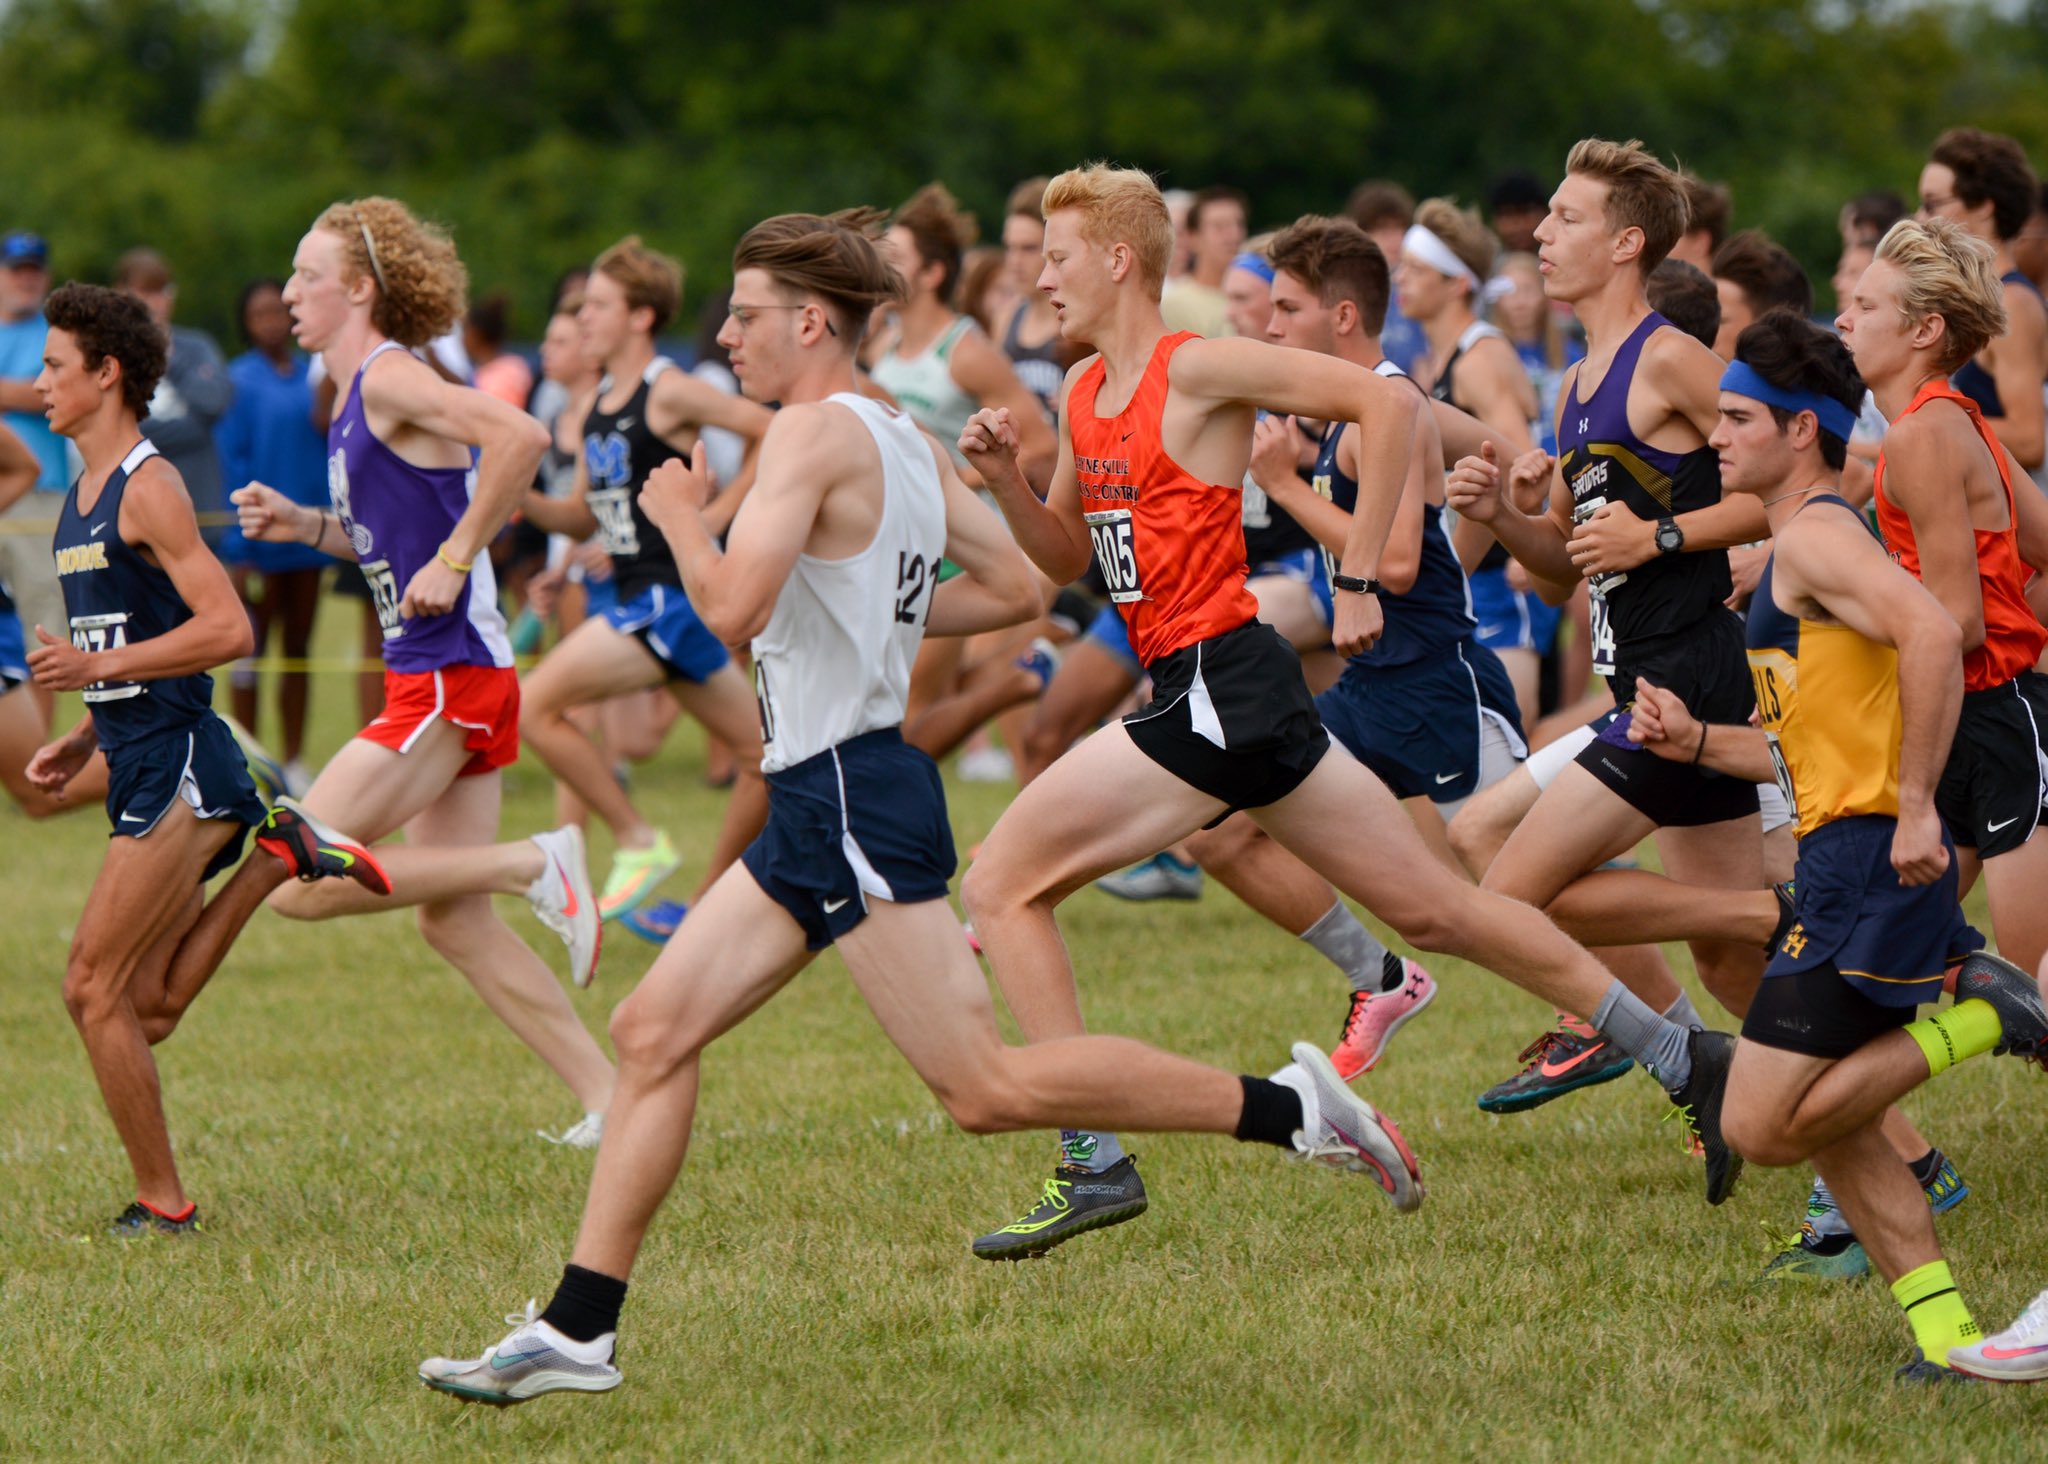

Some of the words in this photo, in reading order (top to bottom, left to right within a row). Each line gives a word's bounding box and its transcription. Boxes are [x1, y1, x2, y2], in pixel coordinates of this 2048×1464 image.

[1093, 484, 1139, 501] COUNTRY
[1589, 599, 1616, 662] 34
[1601, 757, 1629, 781] Reebok
[1074, 1184, 1110, 1195] HAVOK
